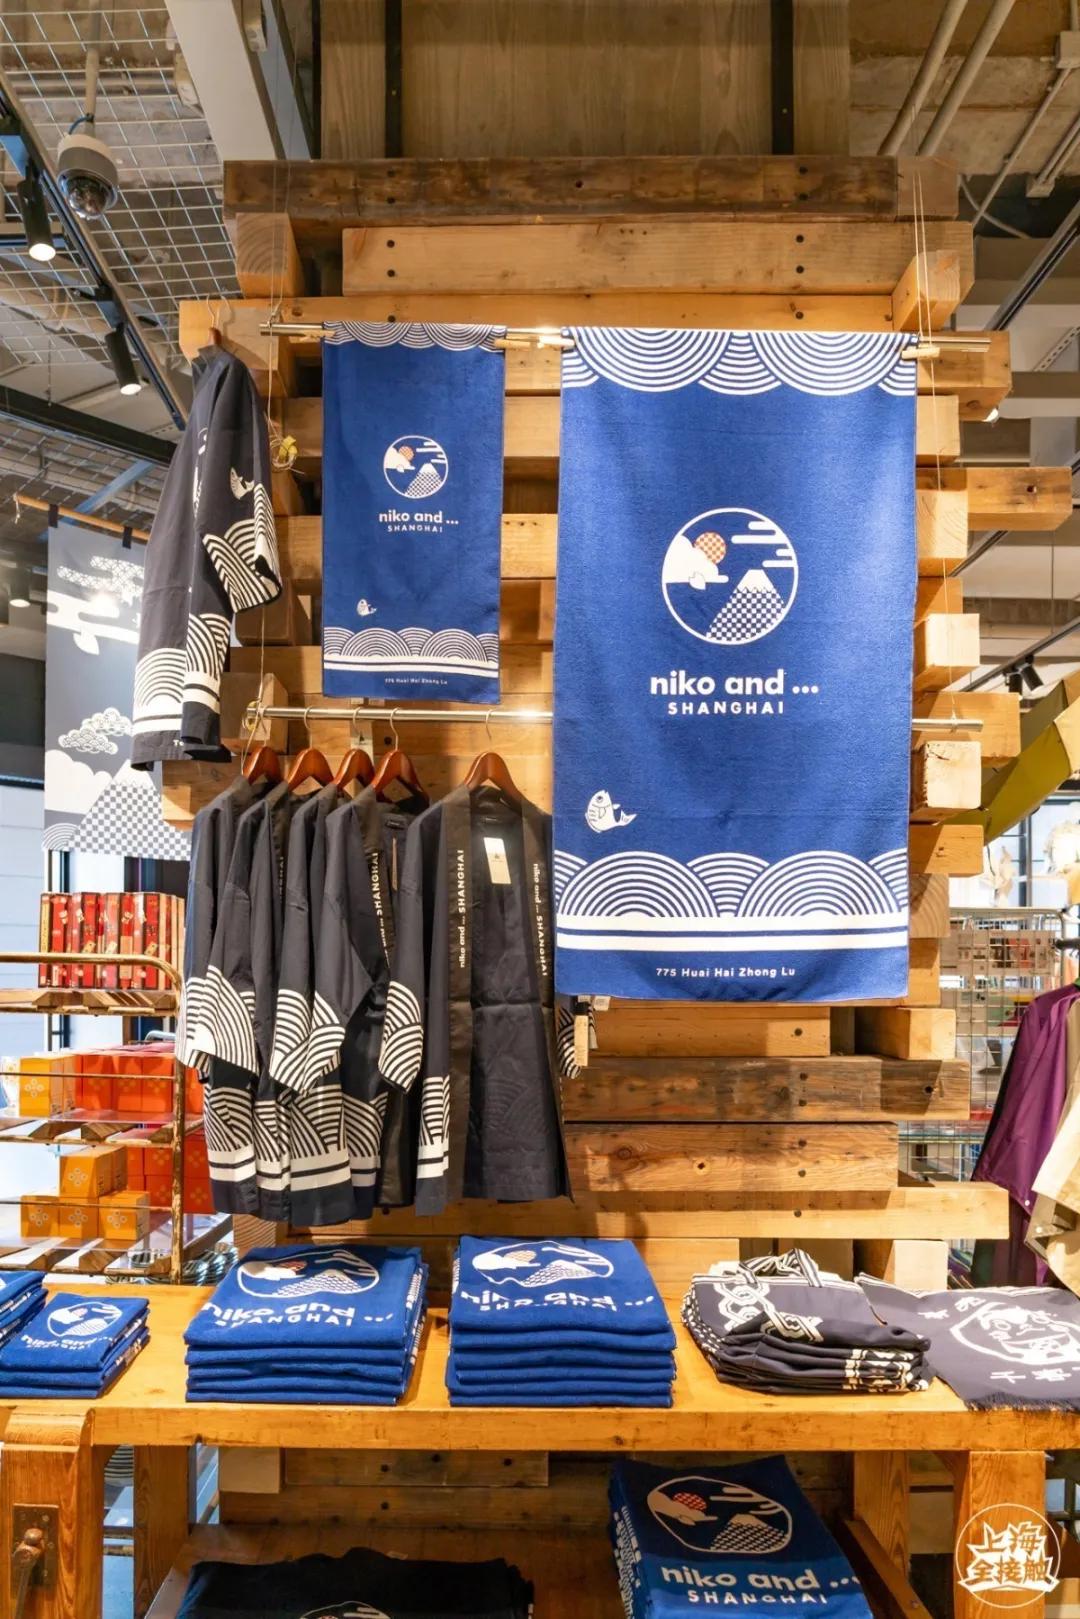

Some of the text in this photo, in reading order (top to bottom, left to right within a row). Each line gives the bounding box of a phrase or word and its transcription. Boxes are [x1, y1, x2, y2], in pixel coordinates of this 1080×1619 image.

[378, 509, 410, 522] niko
[414, 510, 443, 523] and
[387, 524, 443, 533] SHANGHAI
[650, 669, 716, 695] niko
[725, 668, 785, 695] and
[668, 701, 784, 715] SHANGHAI
[456, 849, 466, 914] SHANGHAI
[536, 915, 548, 976] SHANGHAI
[656, 966, 796, 979] 775 Huai Hai Zhong Lu
[200, 1302, 274, 1321] niko
[285, 1302, 356, 1318] and
[661, 1566, 737, 1587] niko
[748, 1569, 821, 1591] and
[687, 1589, 828, 1604] SHANGHAI
